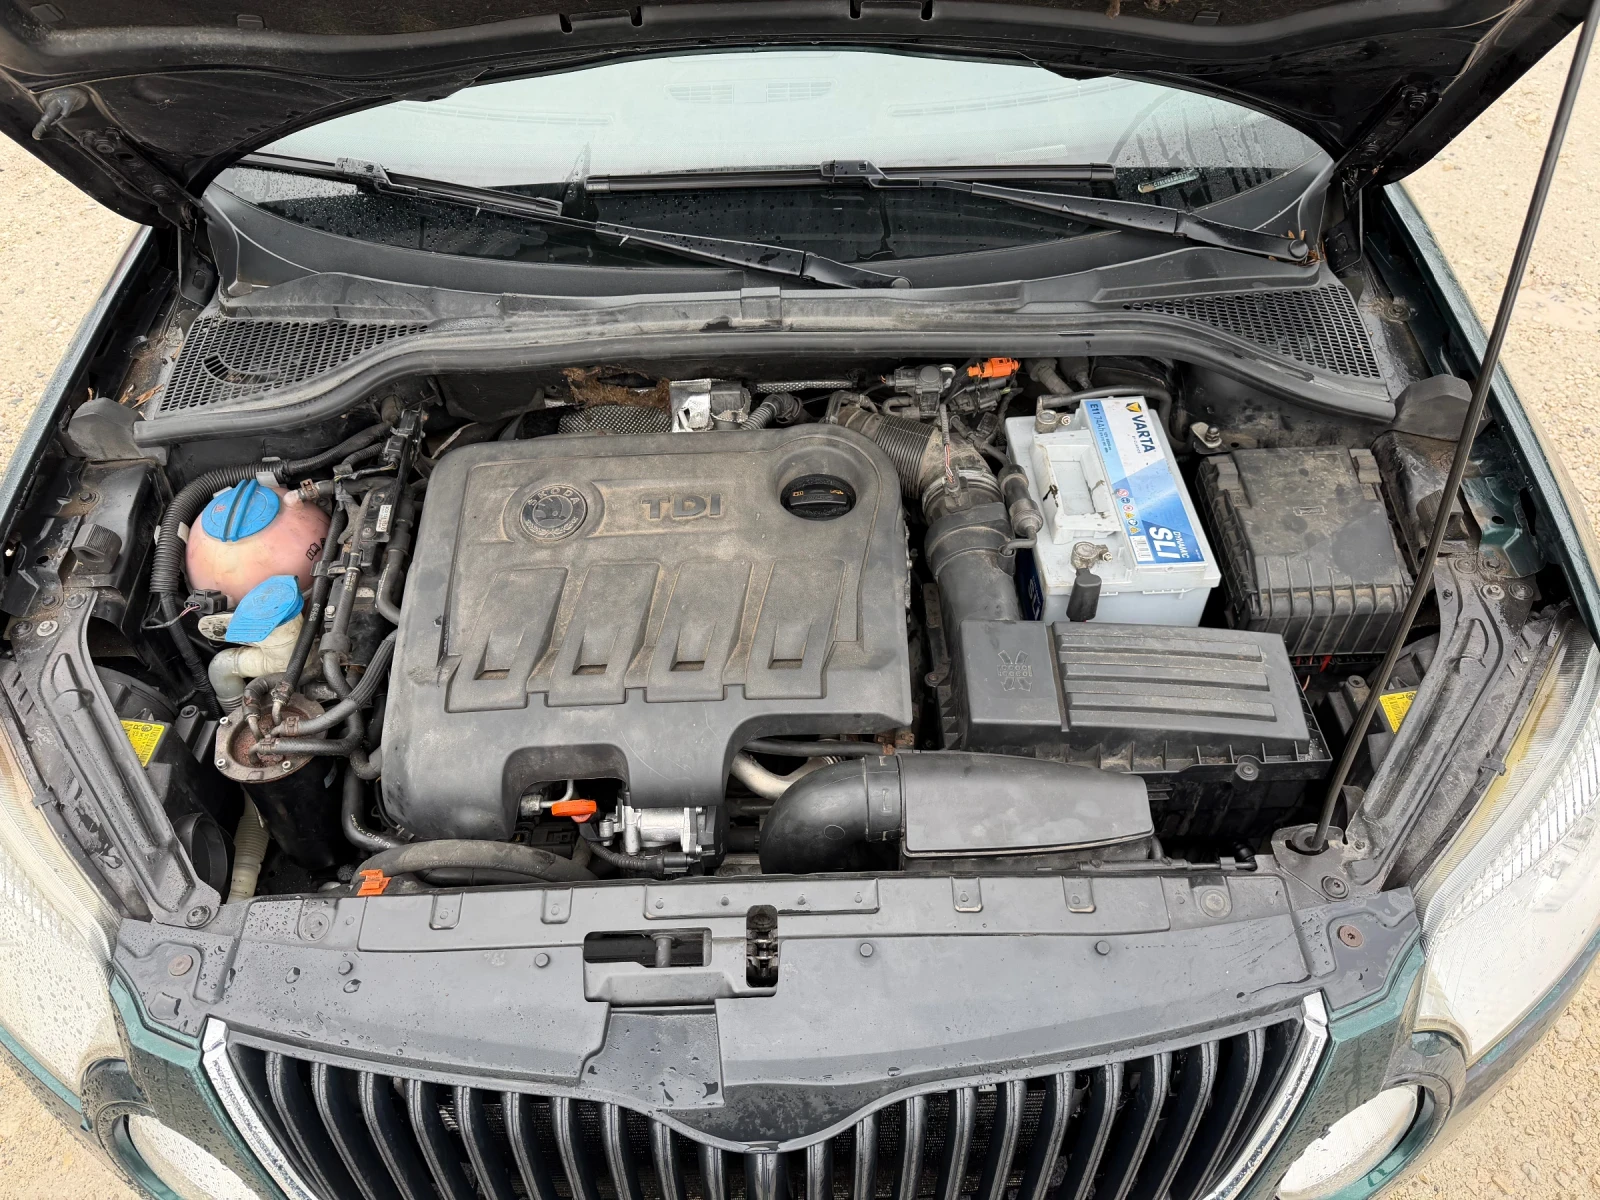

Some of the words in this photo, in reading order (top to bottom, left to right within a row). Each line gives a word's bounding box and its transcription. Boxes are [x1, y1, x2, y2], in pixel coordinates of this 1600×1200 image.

[1131, 414, 1155, 453] VARTA
[640, 493, 722, 520] TDI
[1149, 526, 1181, 560] SLI
